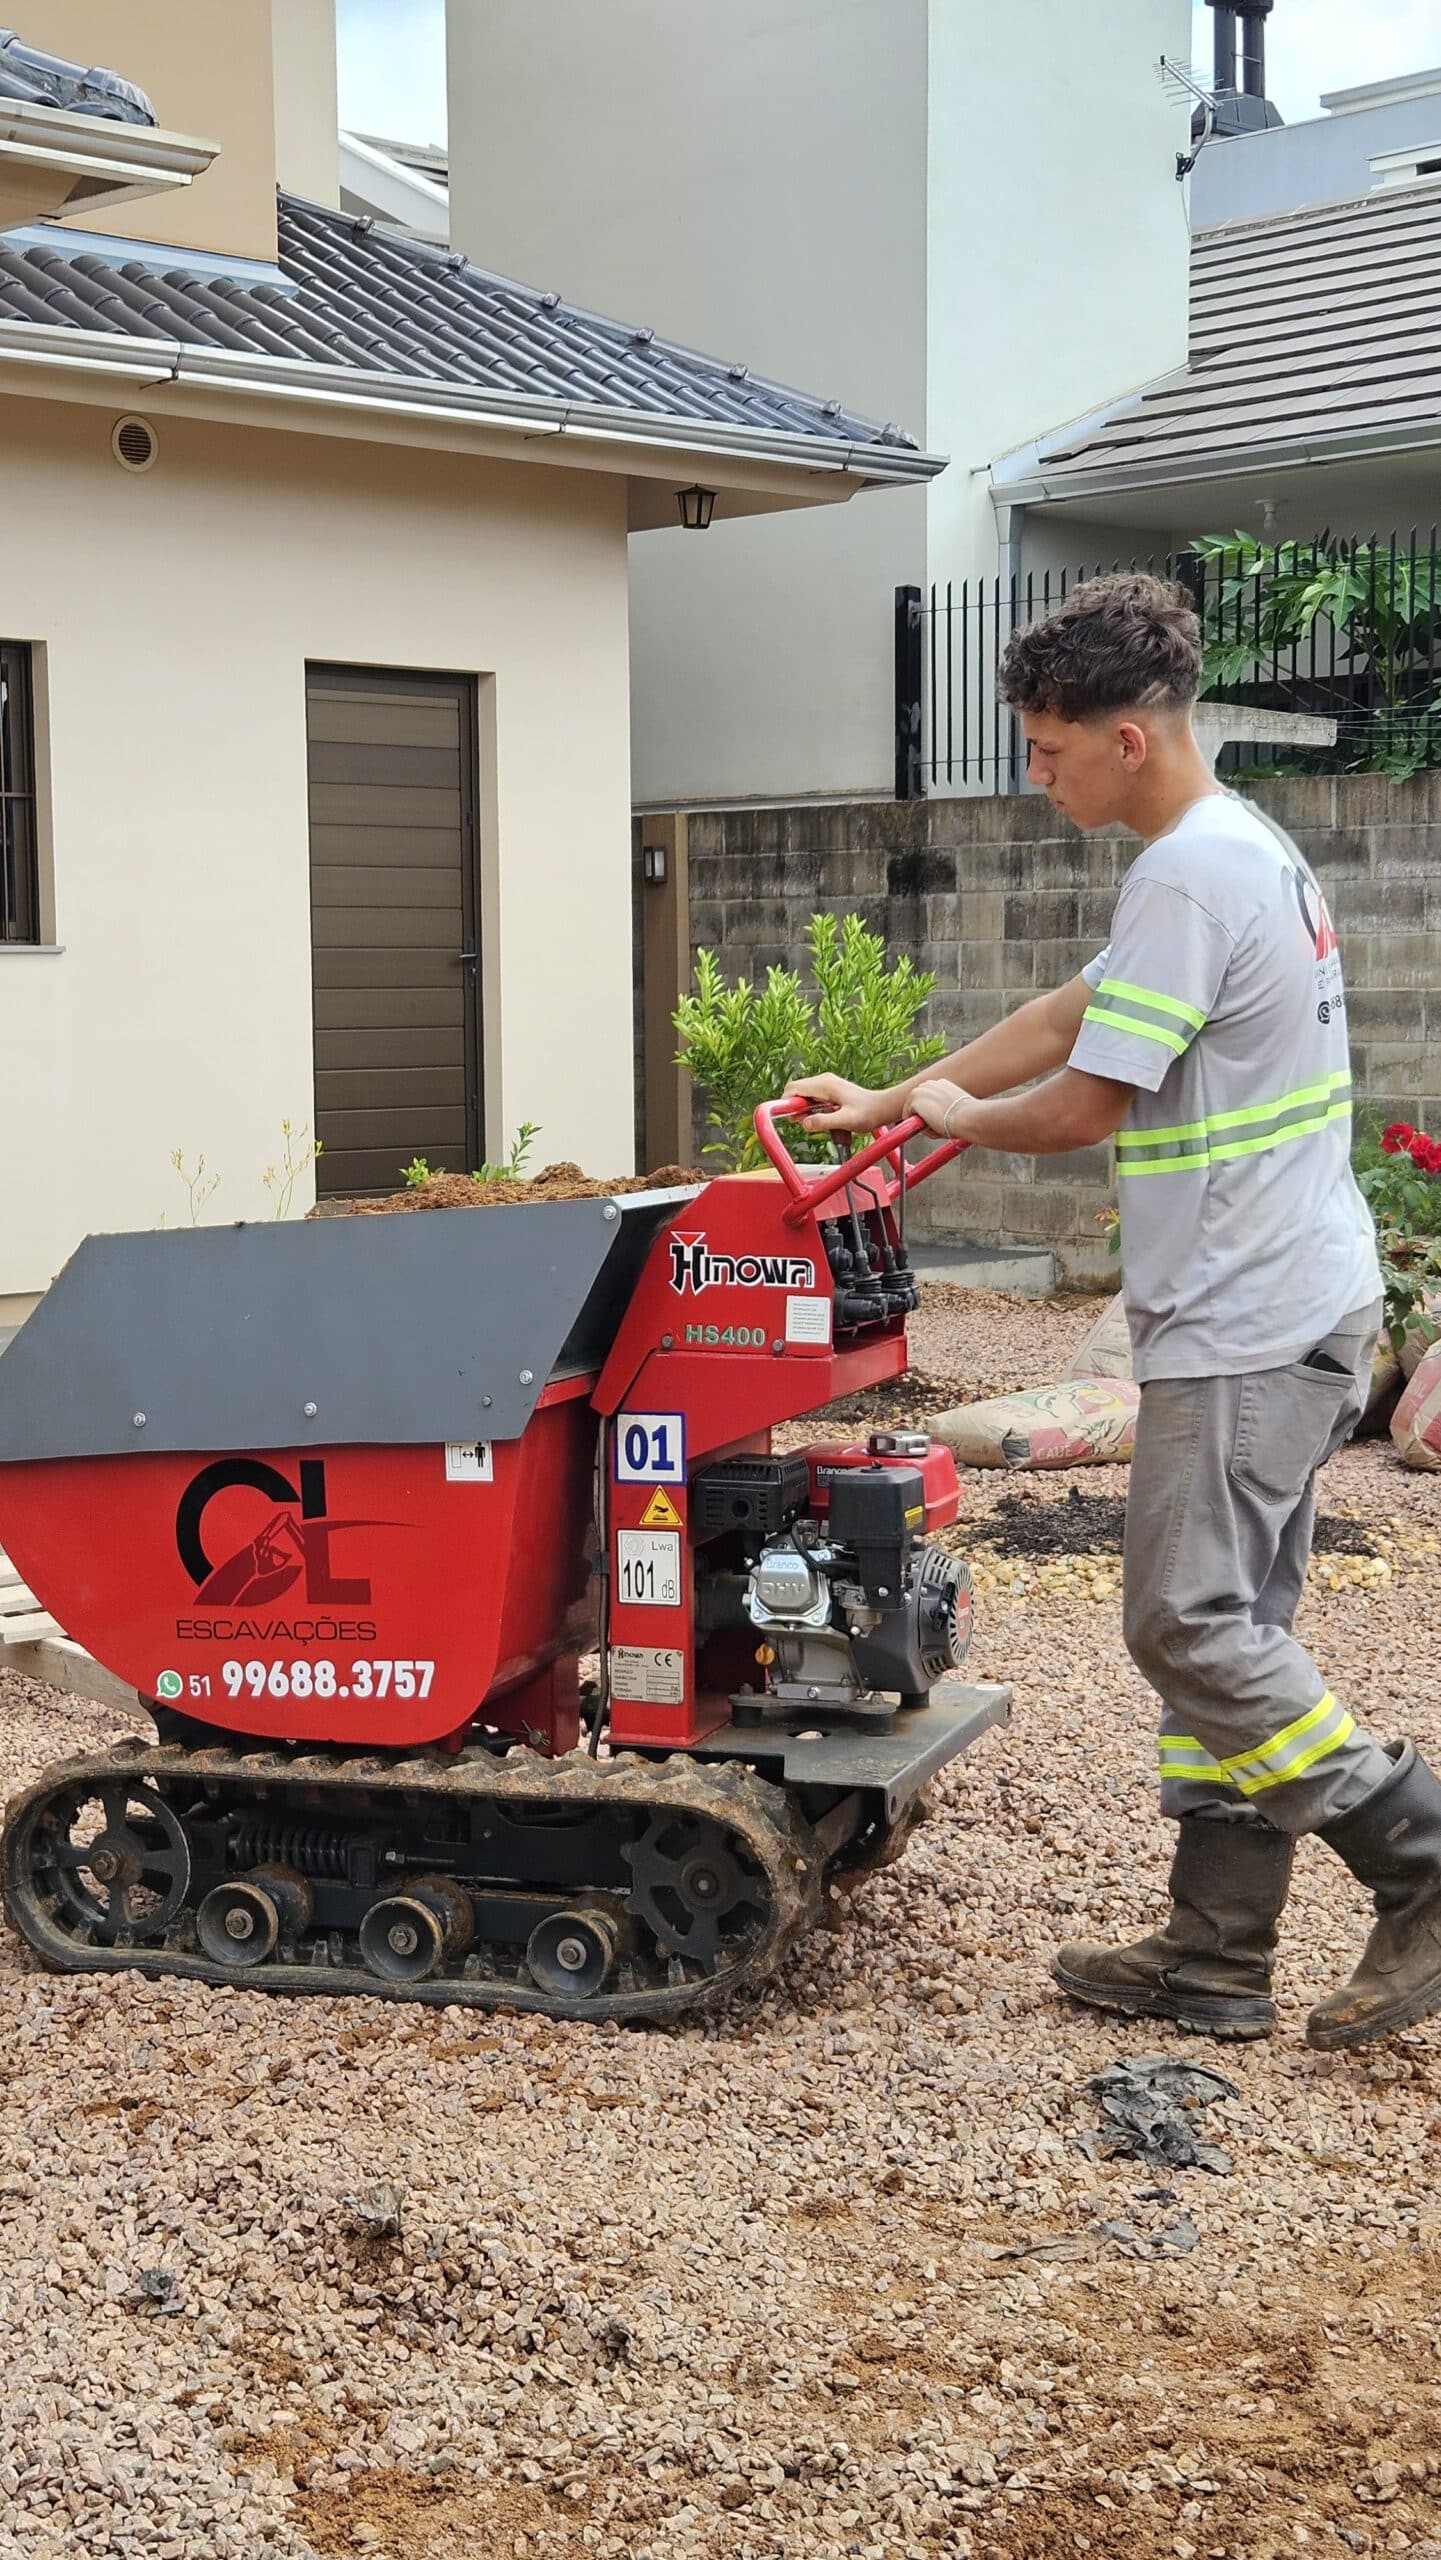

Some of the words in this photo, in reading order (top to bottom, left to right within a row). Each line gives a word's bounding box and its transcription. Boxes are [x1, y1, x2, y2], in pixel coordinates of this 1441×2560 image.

[685, 1323, 765, 1347] HS400
[625, 1424, 675, 1471] 01
[624, 1559, 654, 1598] 101
[661, 1579, 675, 1599] dB
[176, 1616, 377, 1646] ESCAVAÇÕES
[189, 1675, 212, 1697] 51
[222, 1660, 435, 1698] 99688.3757
